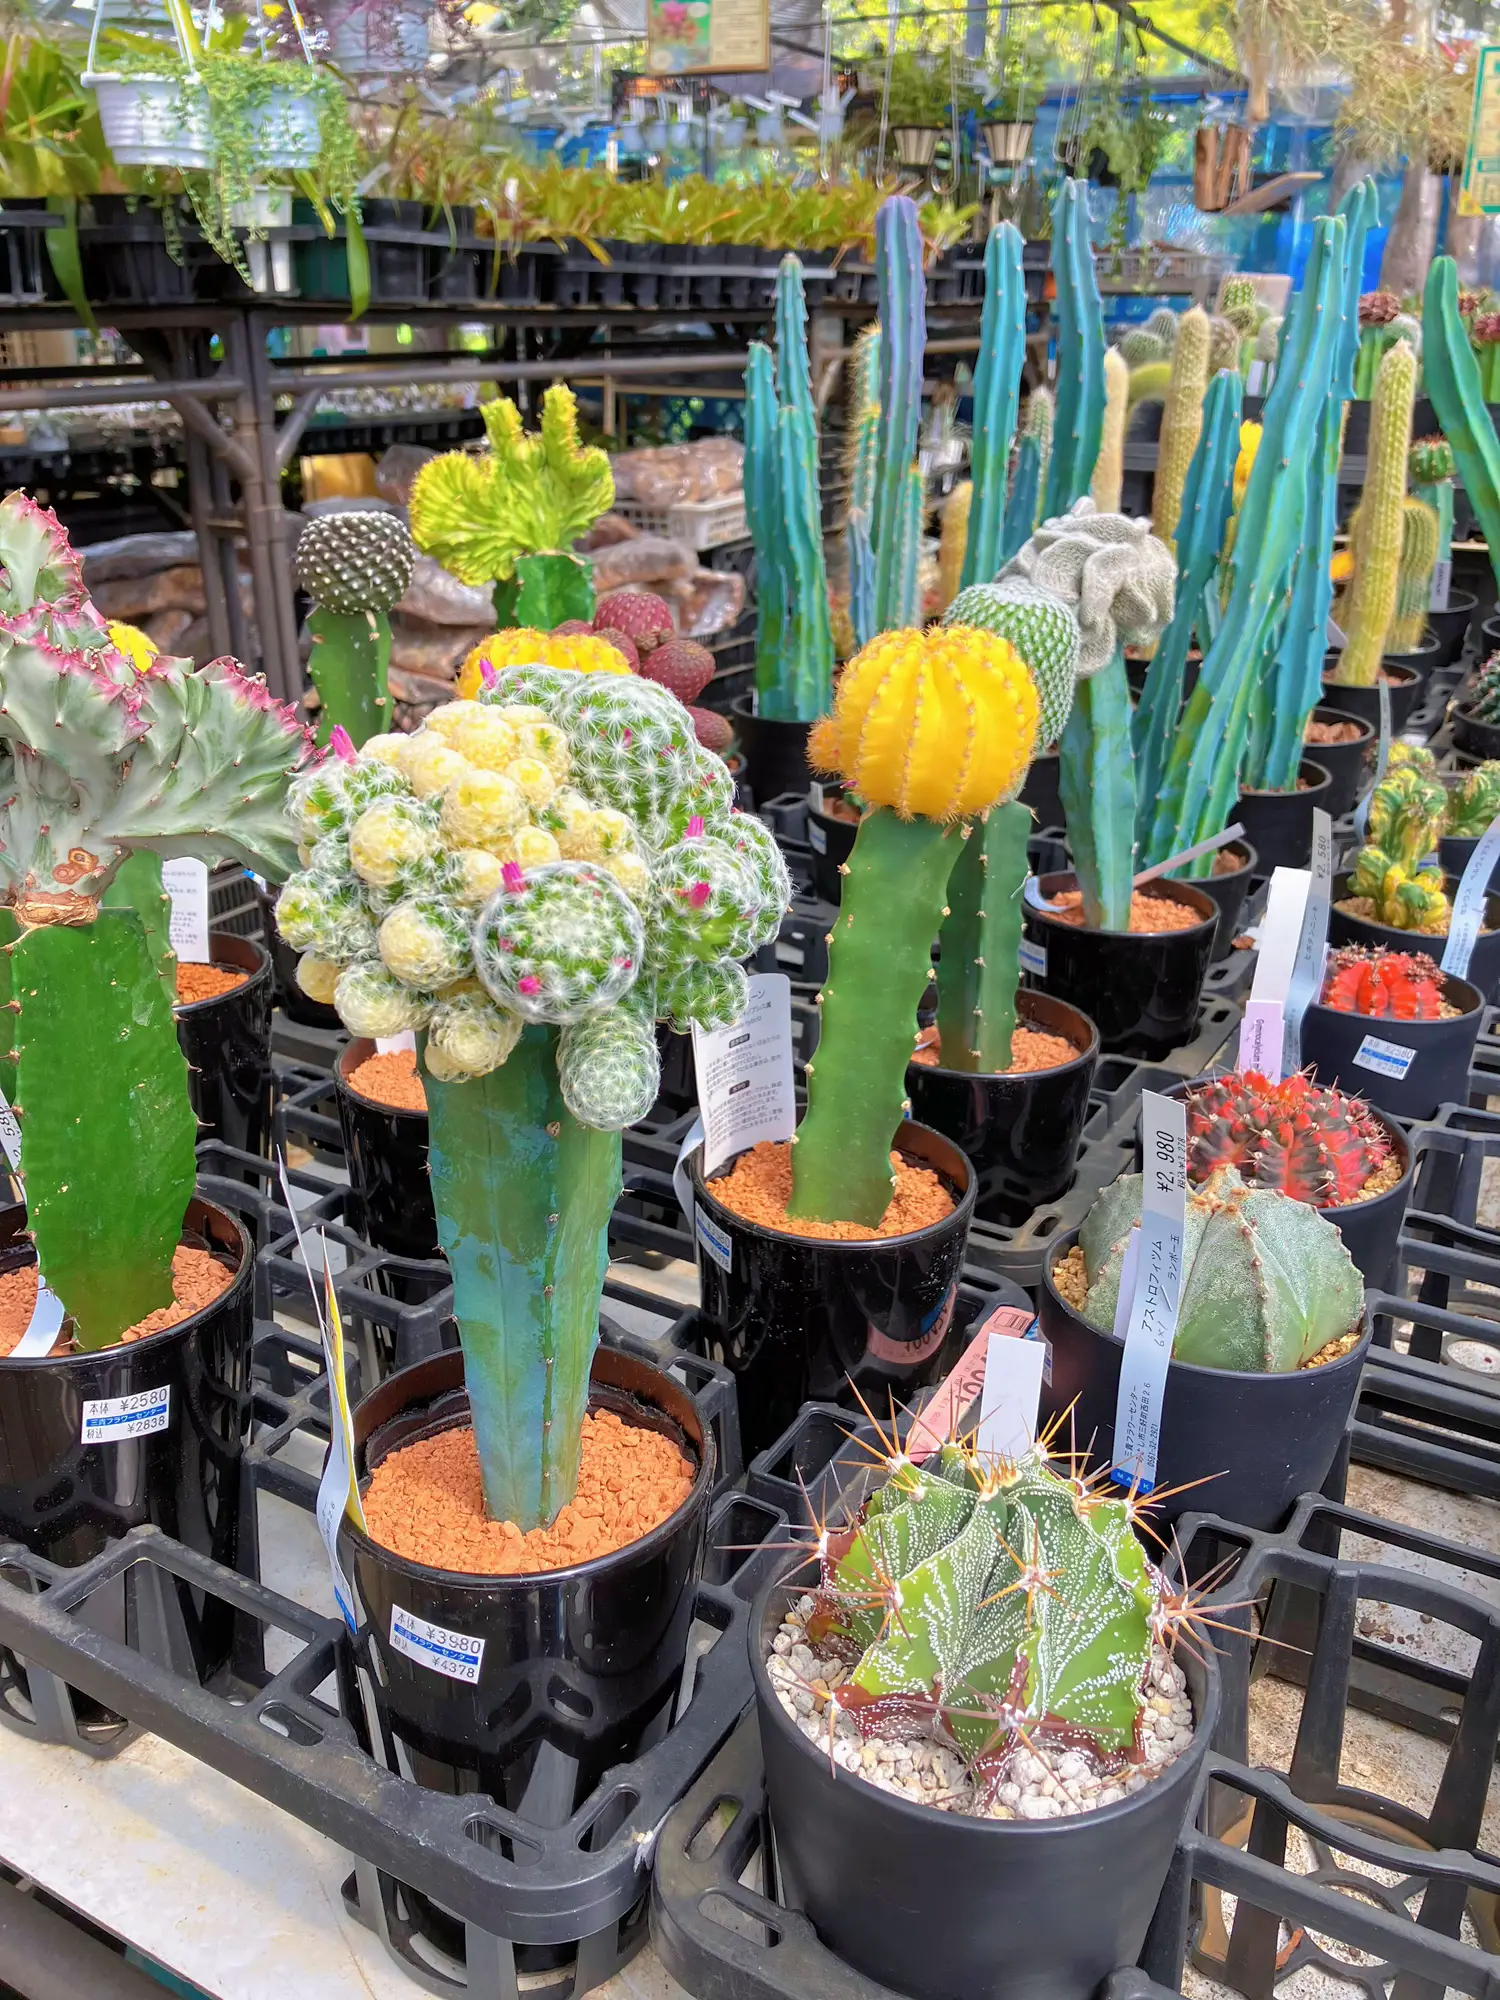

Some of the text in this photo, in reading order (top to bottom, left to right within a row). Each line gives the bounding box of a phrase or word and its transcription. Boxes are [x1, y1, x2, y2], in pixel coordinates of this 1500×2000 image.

[1156, 1130, 1175, 1193] ¥2,980
[1141, 1240, 1162, 1332] アストロフィツム
[89, 1388, 168, 1415] 本体 ¥2580
[87, 1415, 165, 1439] 税込 ¥2838
[396, 1612, 481, 1654] 本体 ¥3980
[431, 1655, 476, 1679] ¥4378
